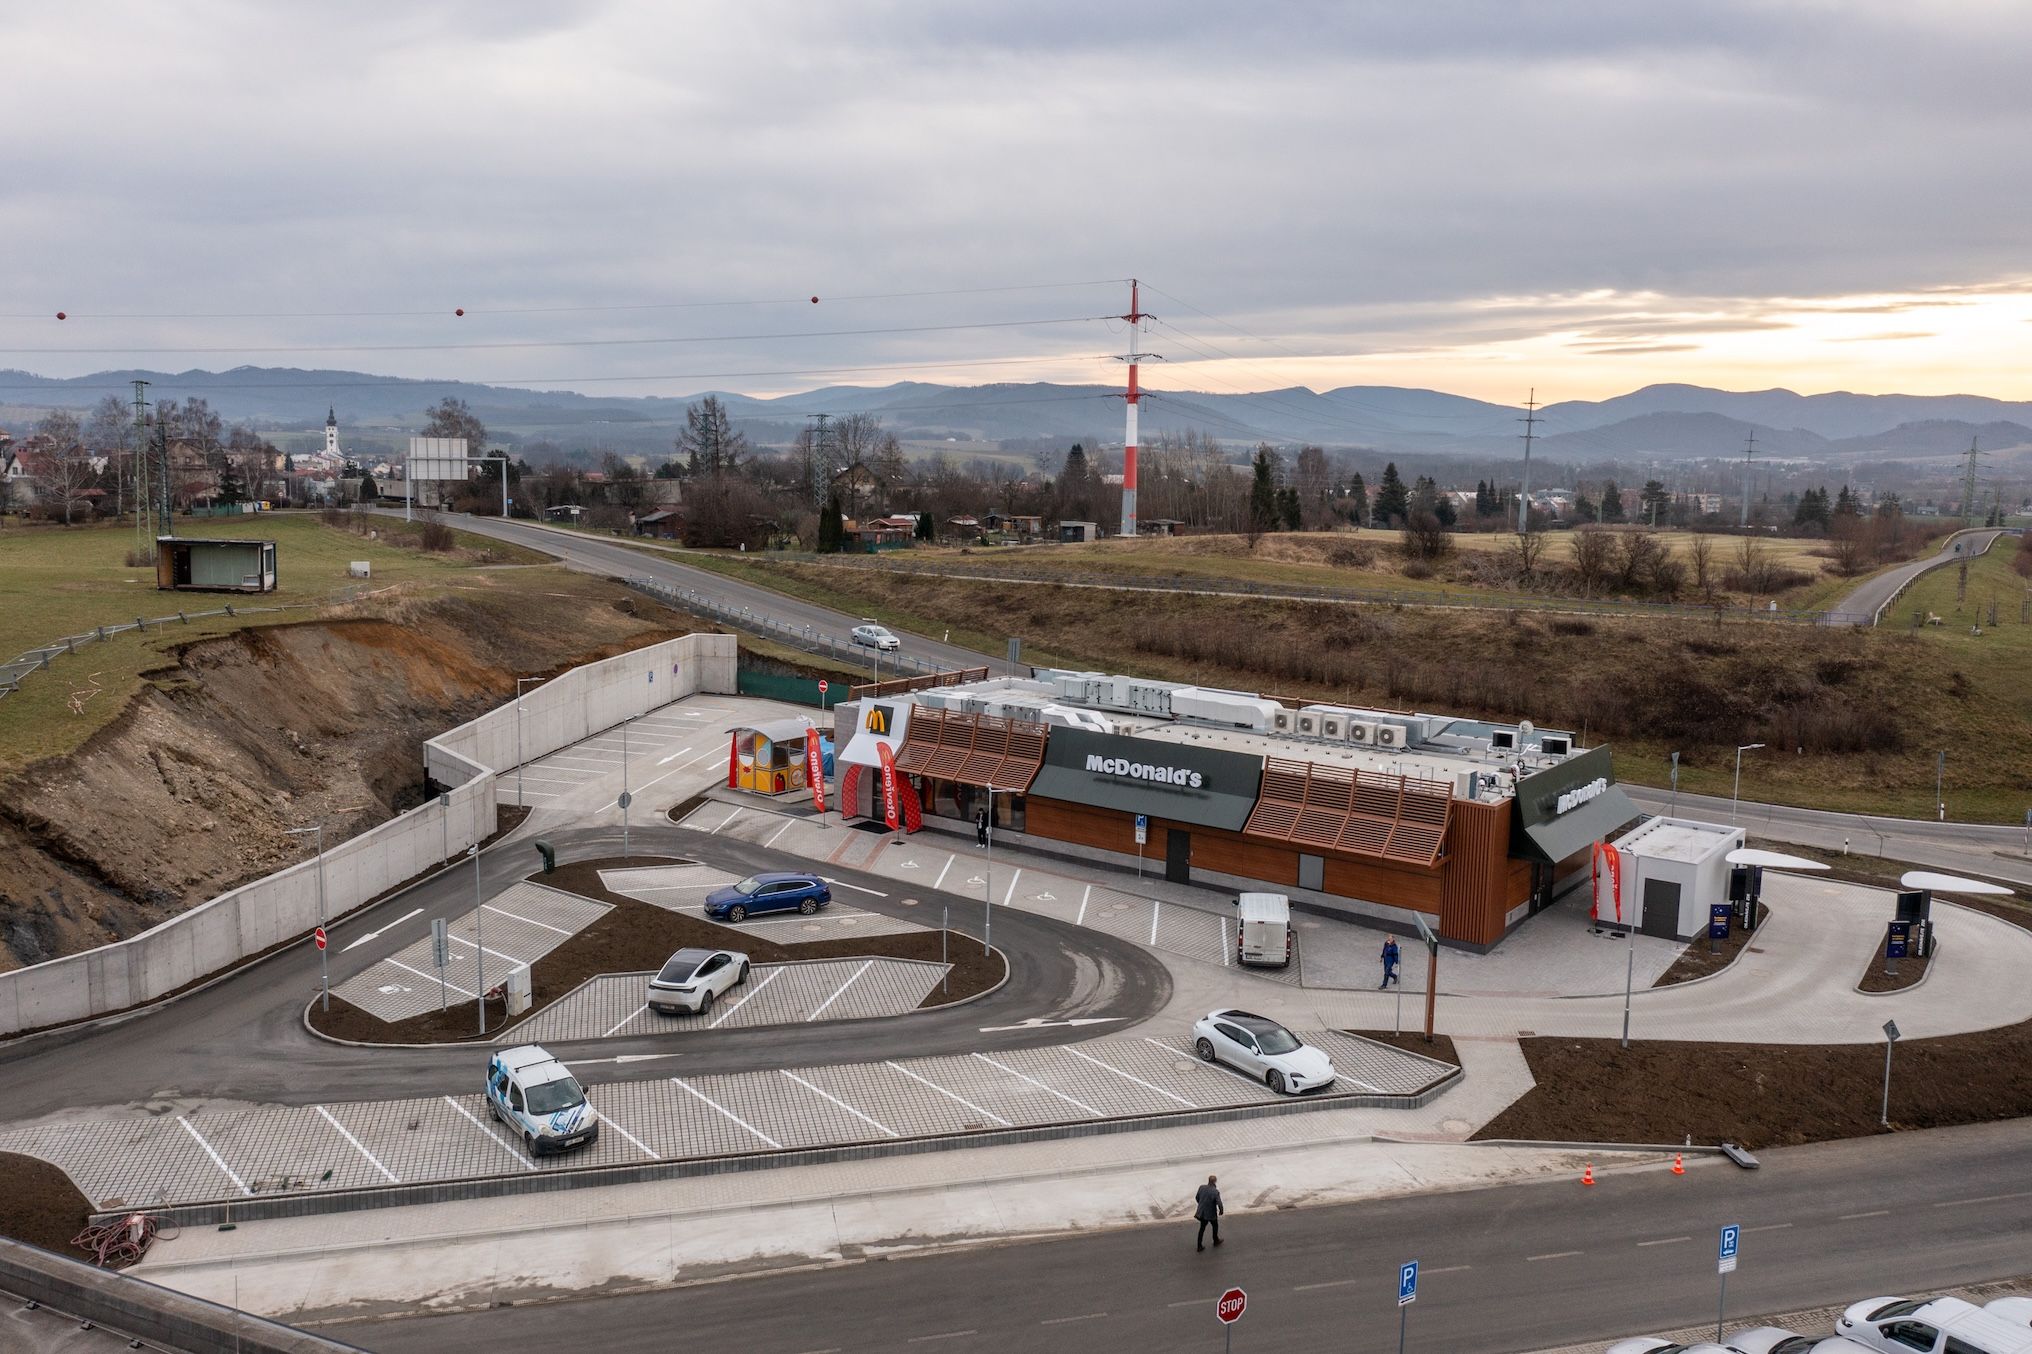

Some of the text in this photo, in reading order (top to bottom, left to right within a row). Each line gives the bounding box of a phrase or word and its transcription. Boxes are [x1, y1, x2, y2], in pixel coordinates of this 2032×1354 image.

[1085, 754, 1202, 788] McDonald's
[1724, 1230, 1735, 1248] P
[1403, 1267, 1414, 1287] P
[1220, 1298, 1244, 1314] STOP
